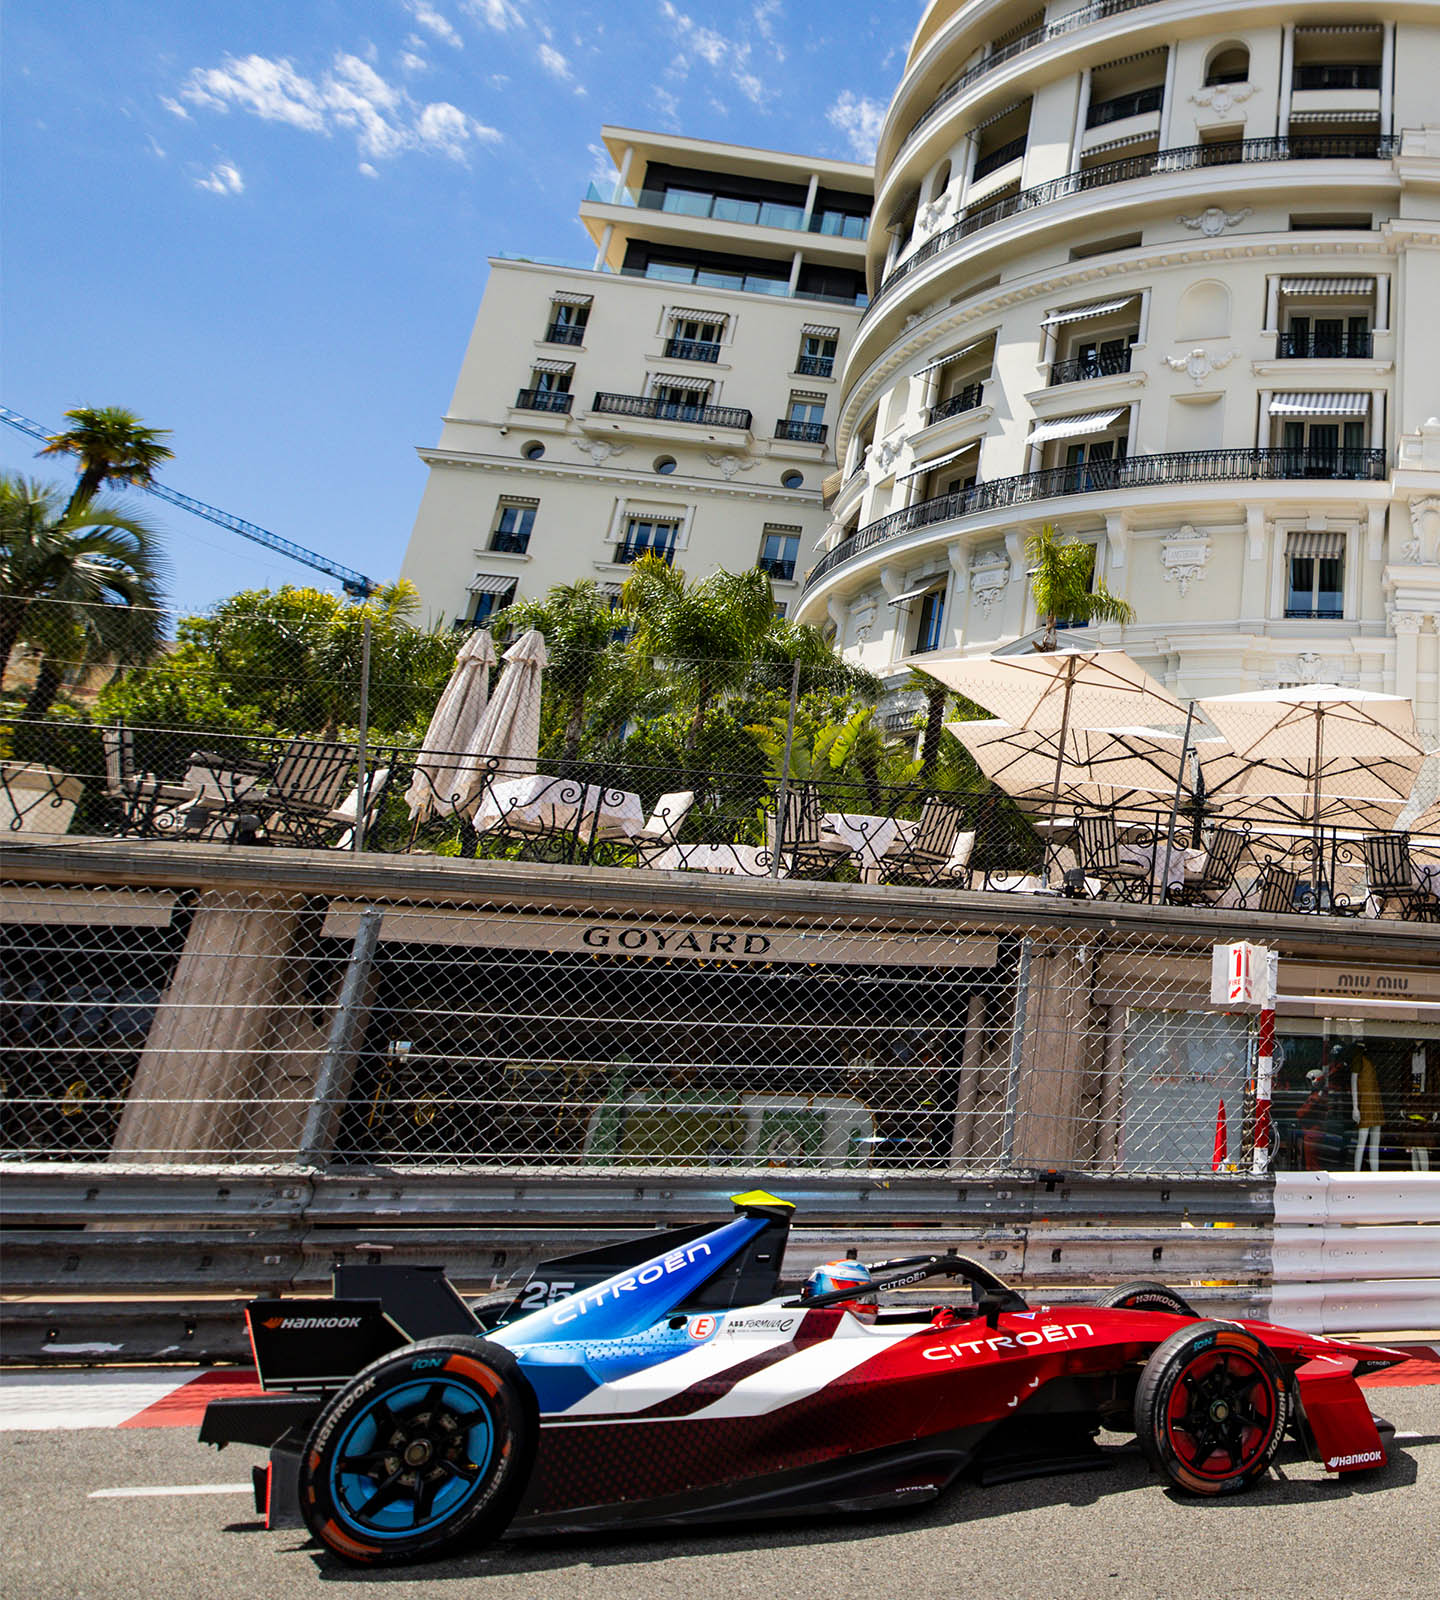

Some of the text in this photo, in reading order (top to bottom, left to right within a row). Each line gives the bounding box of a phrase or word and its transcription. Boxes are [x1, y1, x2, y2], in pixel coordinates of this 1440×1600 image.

[583, 926, 771, 955] GOYARD
[520, 1281, 576, 1309] 25
[695, 1318, 709, 1335] E
